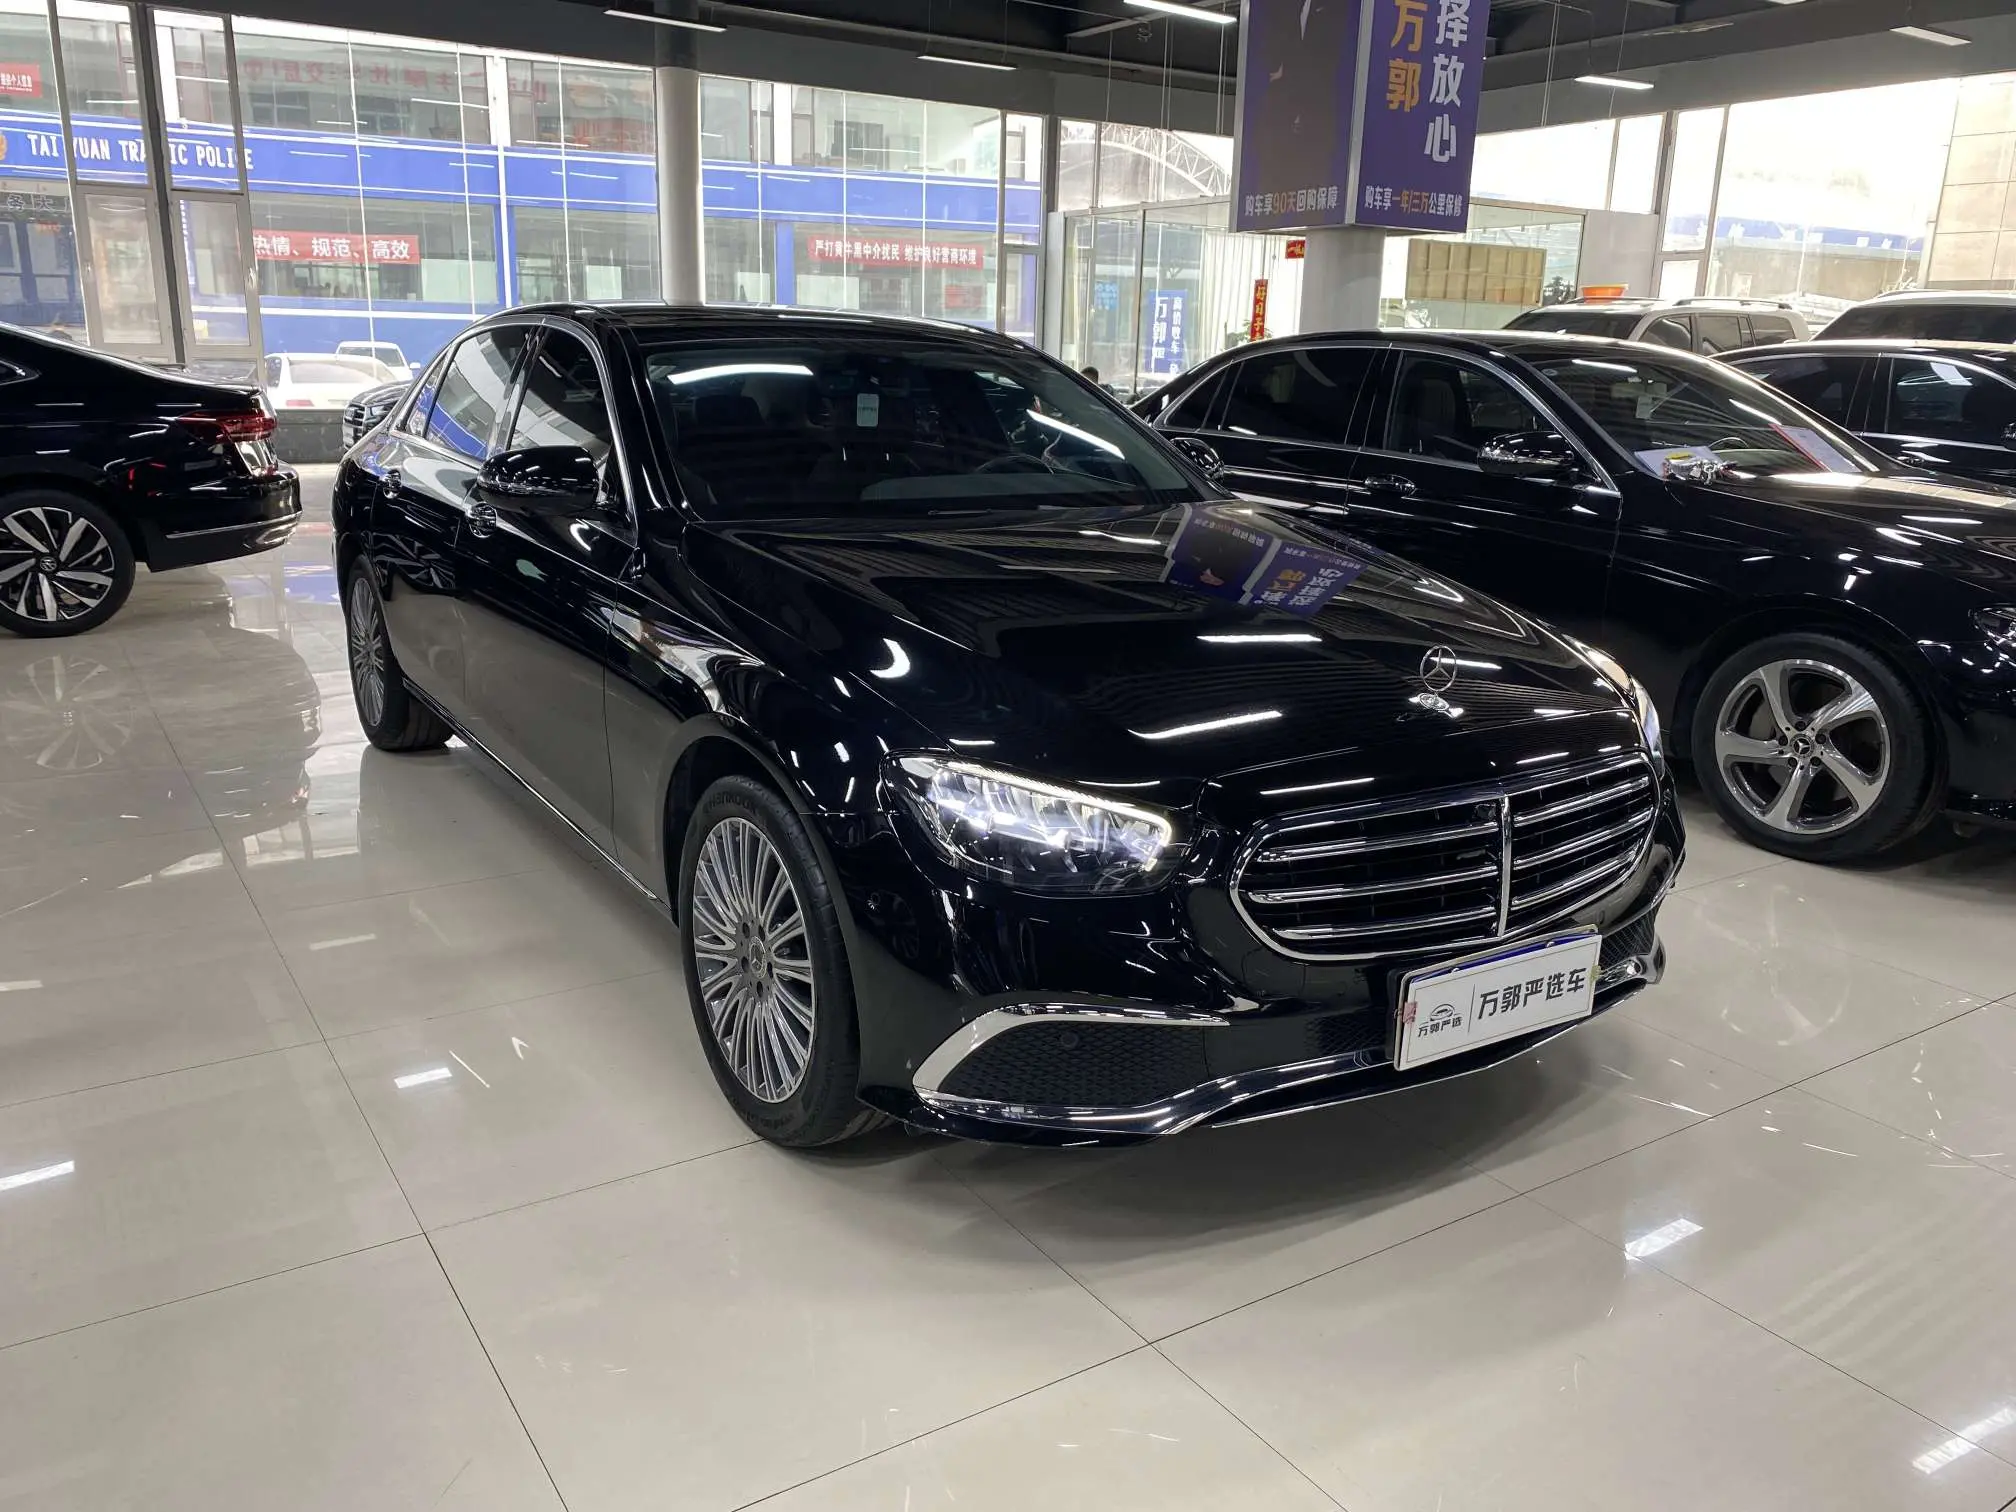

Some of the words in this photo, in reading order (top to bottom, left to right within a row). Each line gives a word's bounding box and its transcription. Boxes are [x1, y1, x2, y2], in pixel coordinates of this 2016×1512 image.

[1386, 0, 1428, 112] 万郭
[27, 134, 59, 157] TAI
[73, 137, 111, 161] YUAN
[118, 139, 188, 166] TRAIC
[196, 143, 254, 170] POLIE
[1245, 185, 1338, 217] 购车享90天回购保障
[253, 235, 411, 261] 热情、规范、高效
[1478, 967, 1587, 1020] 万郭严选车
[1417, 1016, 1463, 1038] 万郭严选
